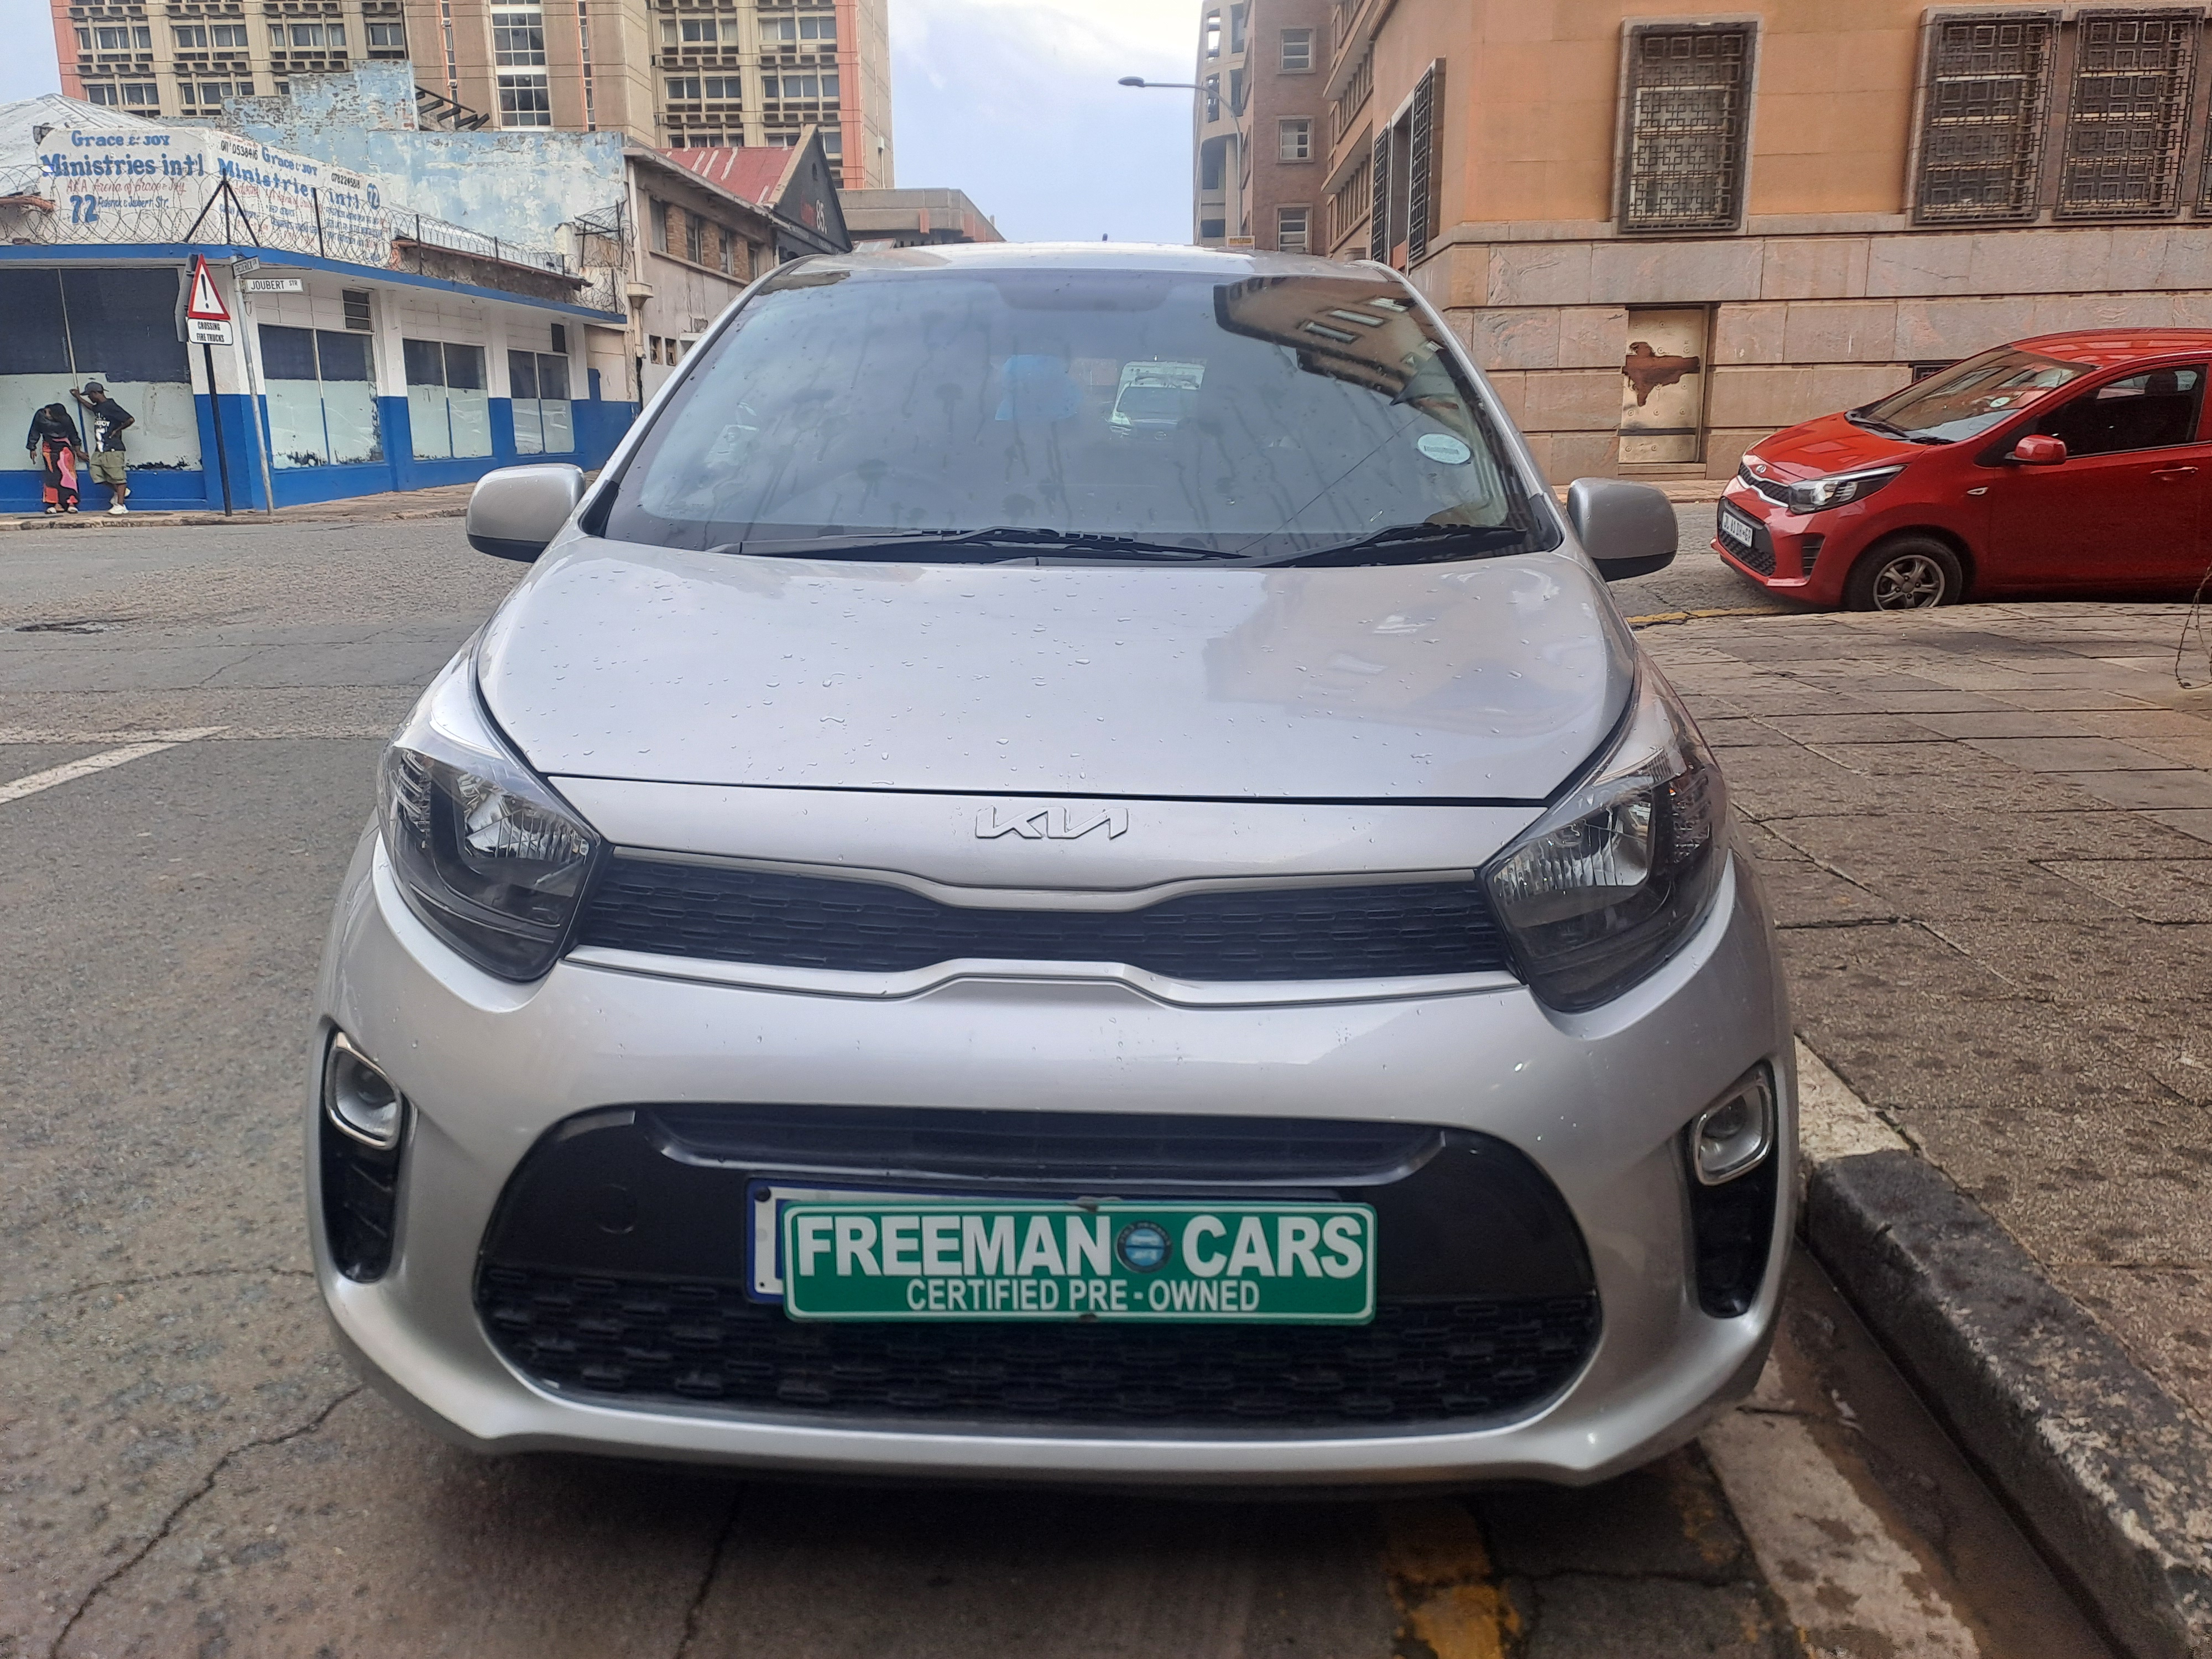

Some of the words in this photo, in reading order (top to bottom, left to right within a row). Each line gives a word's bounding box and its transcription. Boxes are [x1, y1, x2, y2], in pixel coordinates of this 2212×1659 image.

[71, 130, 124, 147] Grace
[143, 135, 170, 146] JOY
[40, 153, 156, 177] Ministries
[262, 147, 295, 170] Grace
[70, 194, 99, 224] 72
[251, 280, 284, 290] JOUBERT
[196, 333, 206, 341] FIRE
[206, 333, 225, 342] TRUCKS
[197, 321, 221, 331] CROSSING
[796, 1215, 1112, 1276] FREEMAN
[1181, 1214, 1364, 1279] CARS
[906, 1279, 1060, 1311] CERTIFIED
